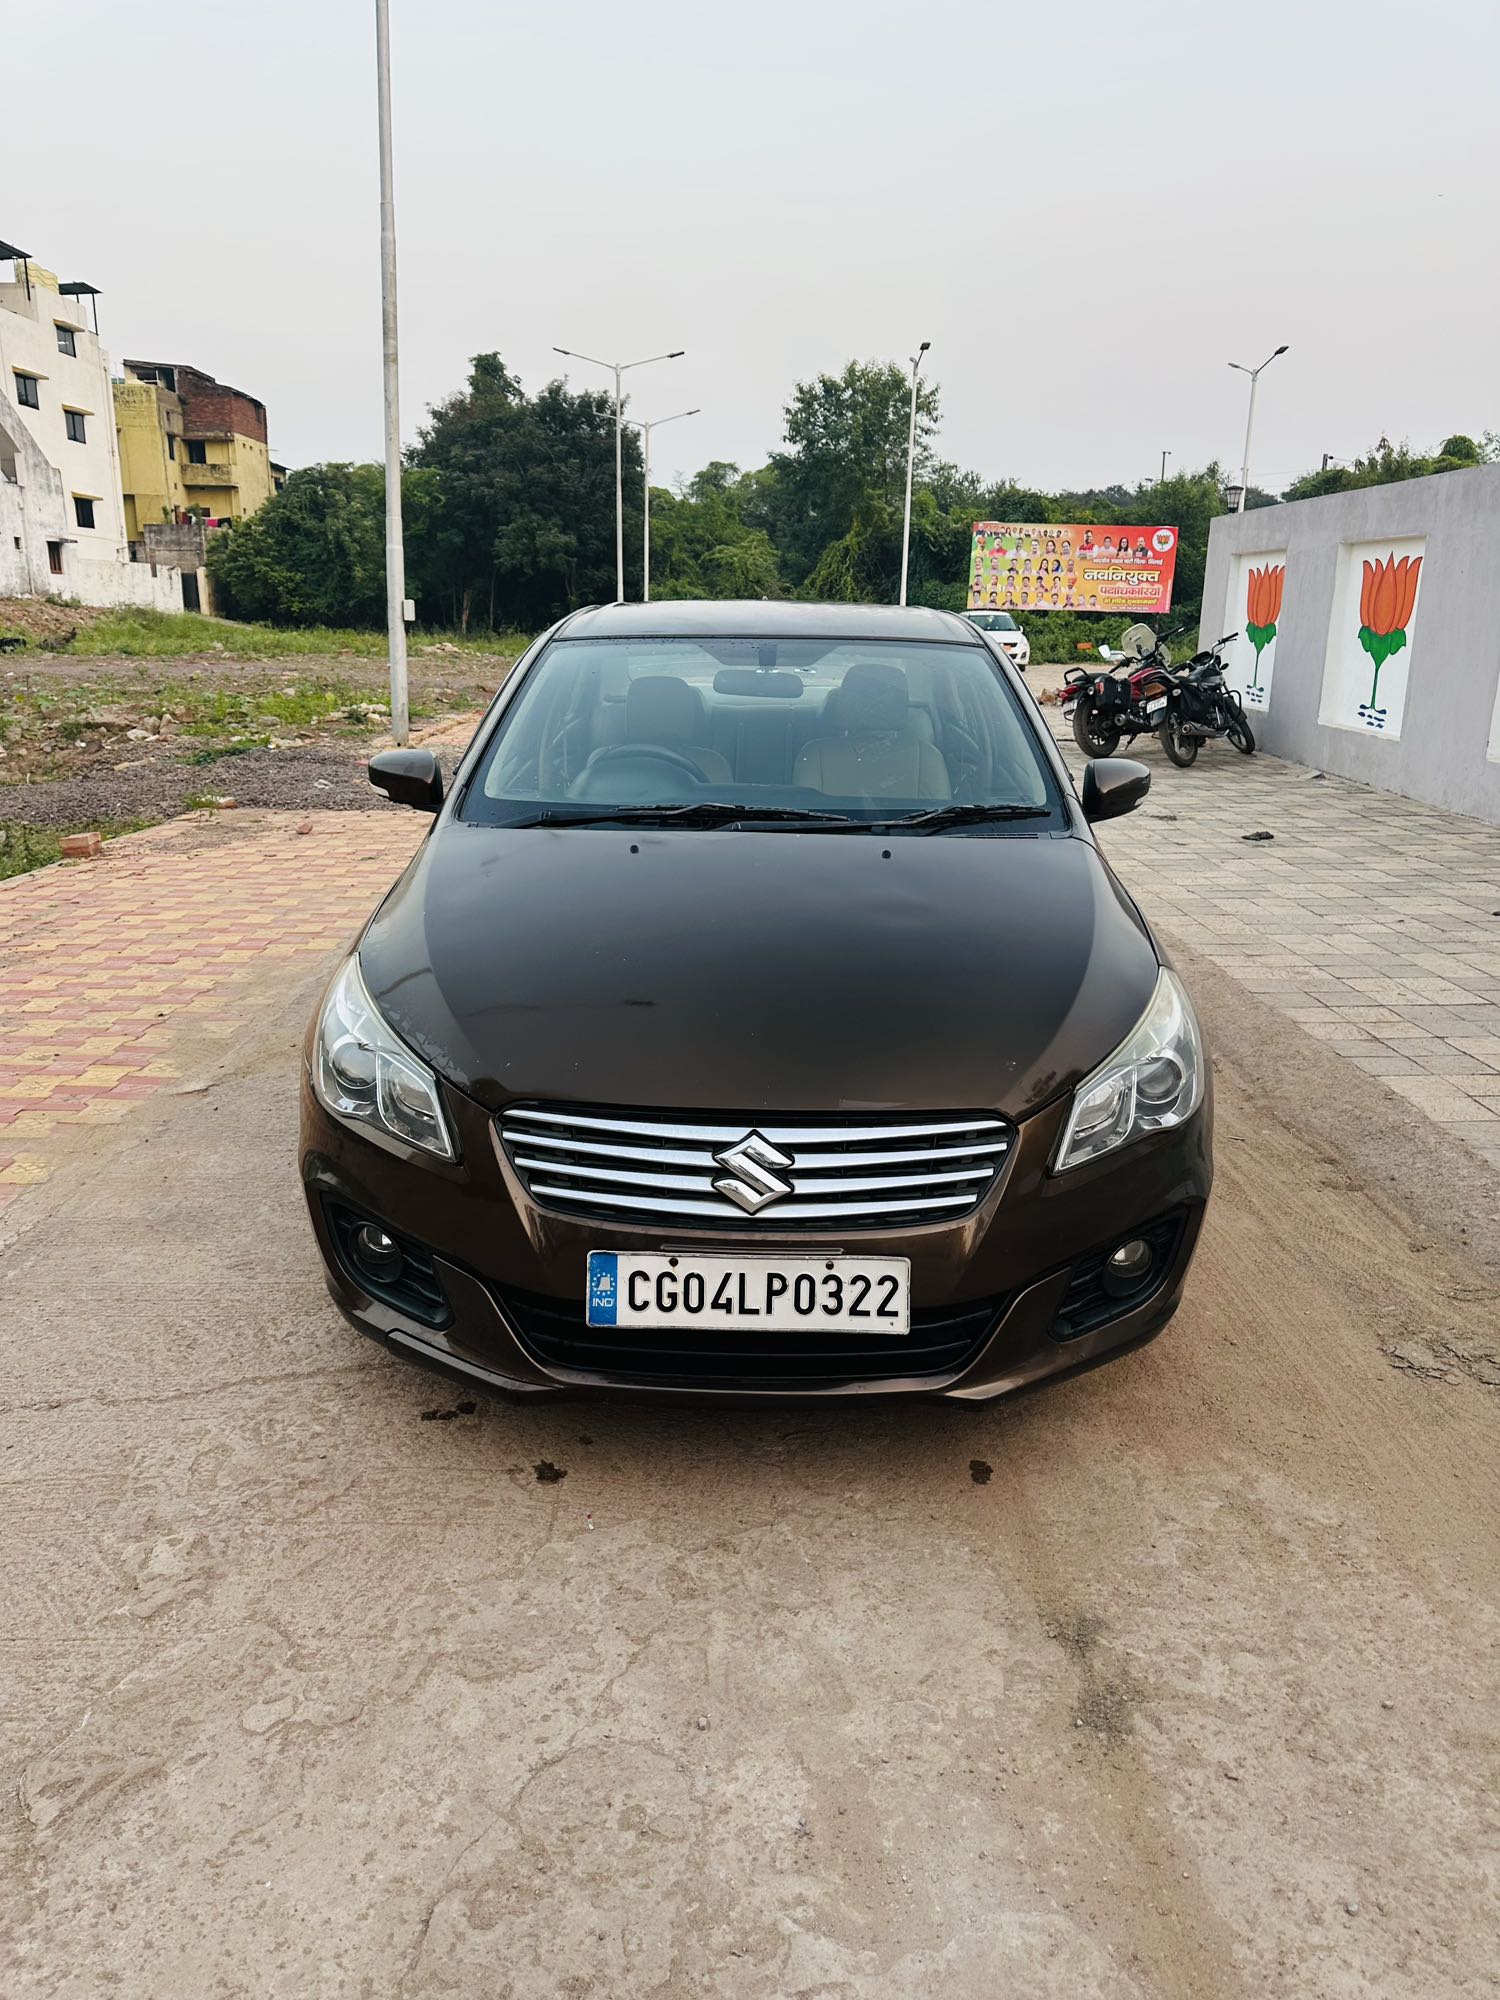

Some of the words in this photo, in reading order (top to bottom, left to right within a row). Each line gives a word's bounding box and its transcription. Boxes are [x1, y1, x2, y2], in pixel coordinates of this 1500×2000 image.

[1084, 566, 1160, 585] नवनियुक्त
[592, 1297, 614, 1307] IND
[628, 1270, 899, 1317] CG04LP0322
